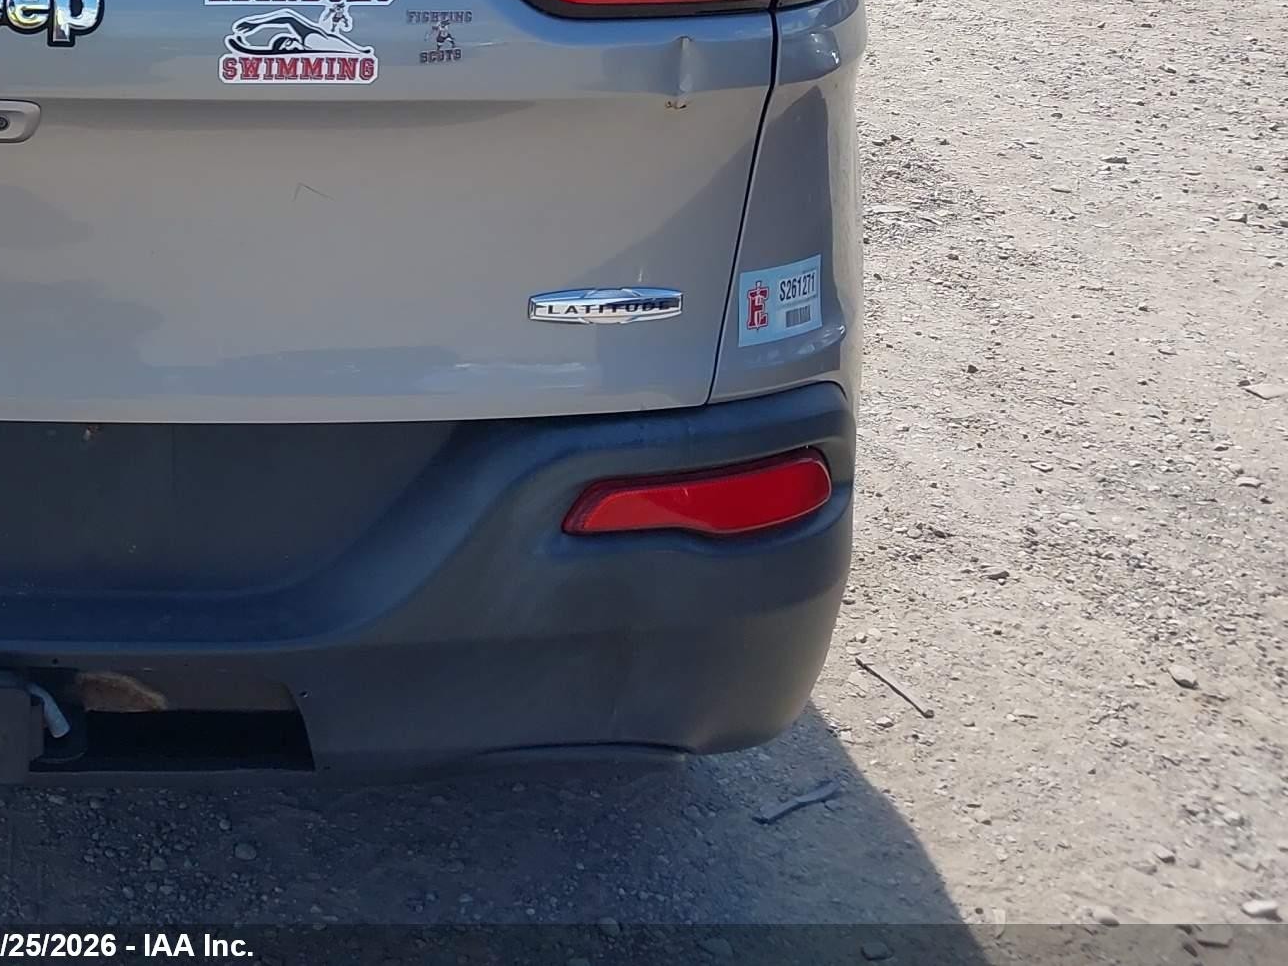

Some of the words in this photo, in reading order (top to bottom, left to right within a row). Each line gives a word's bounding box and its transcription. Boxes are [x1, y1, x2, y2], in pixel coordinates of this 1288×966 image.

[406, 10, 473, 24] FIGHTING
[419, 47, 462, 65] SCOTS
[222, 56, 375, 81] SWIMMING
[779, 273, 815, 302] S261271
[547, 300, 670, 315] LATITUDE
